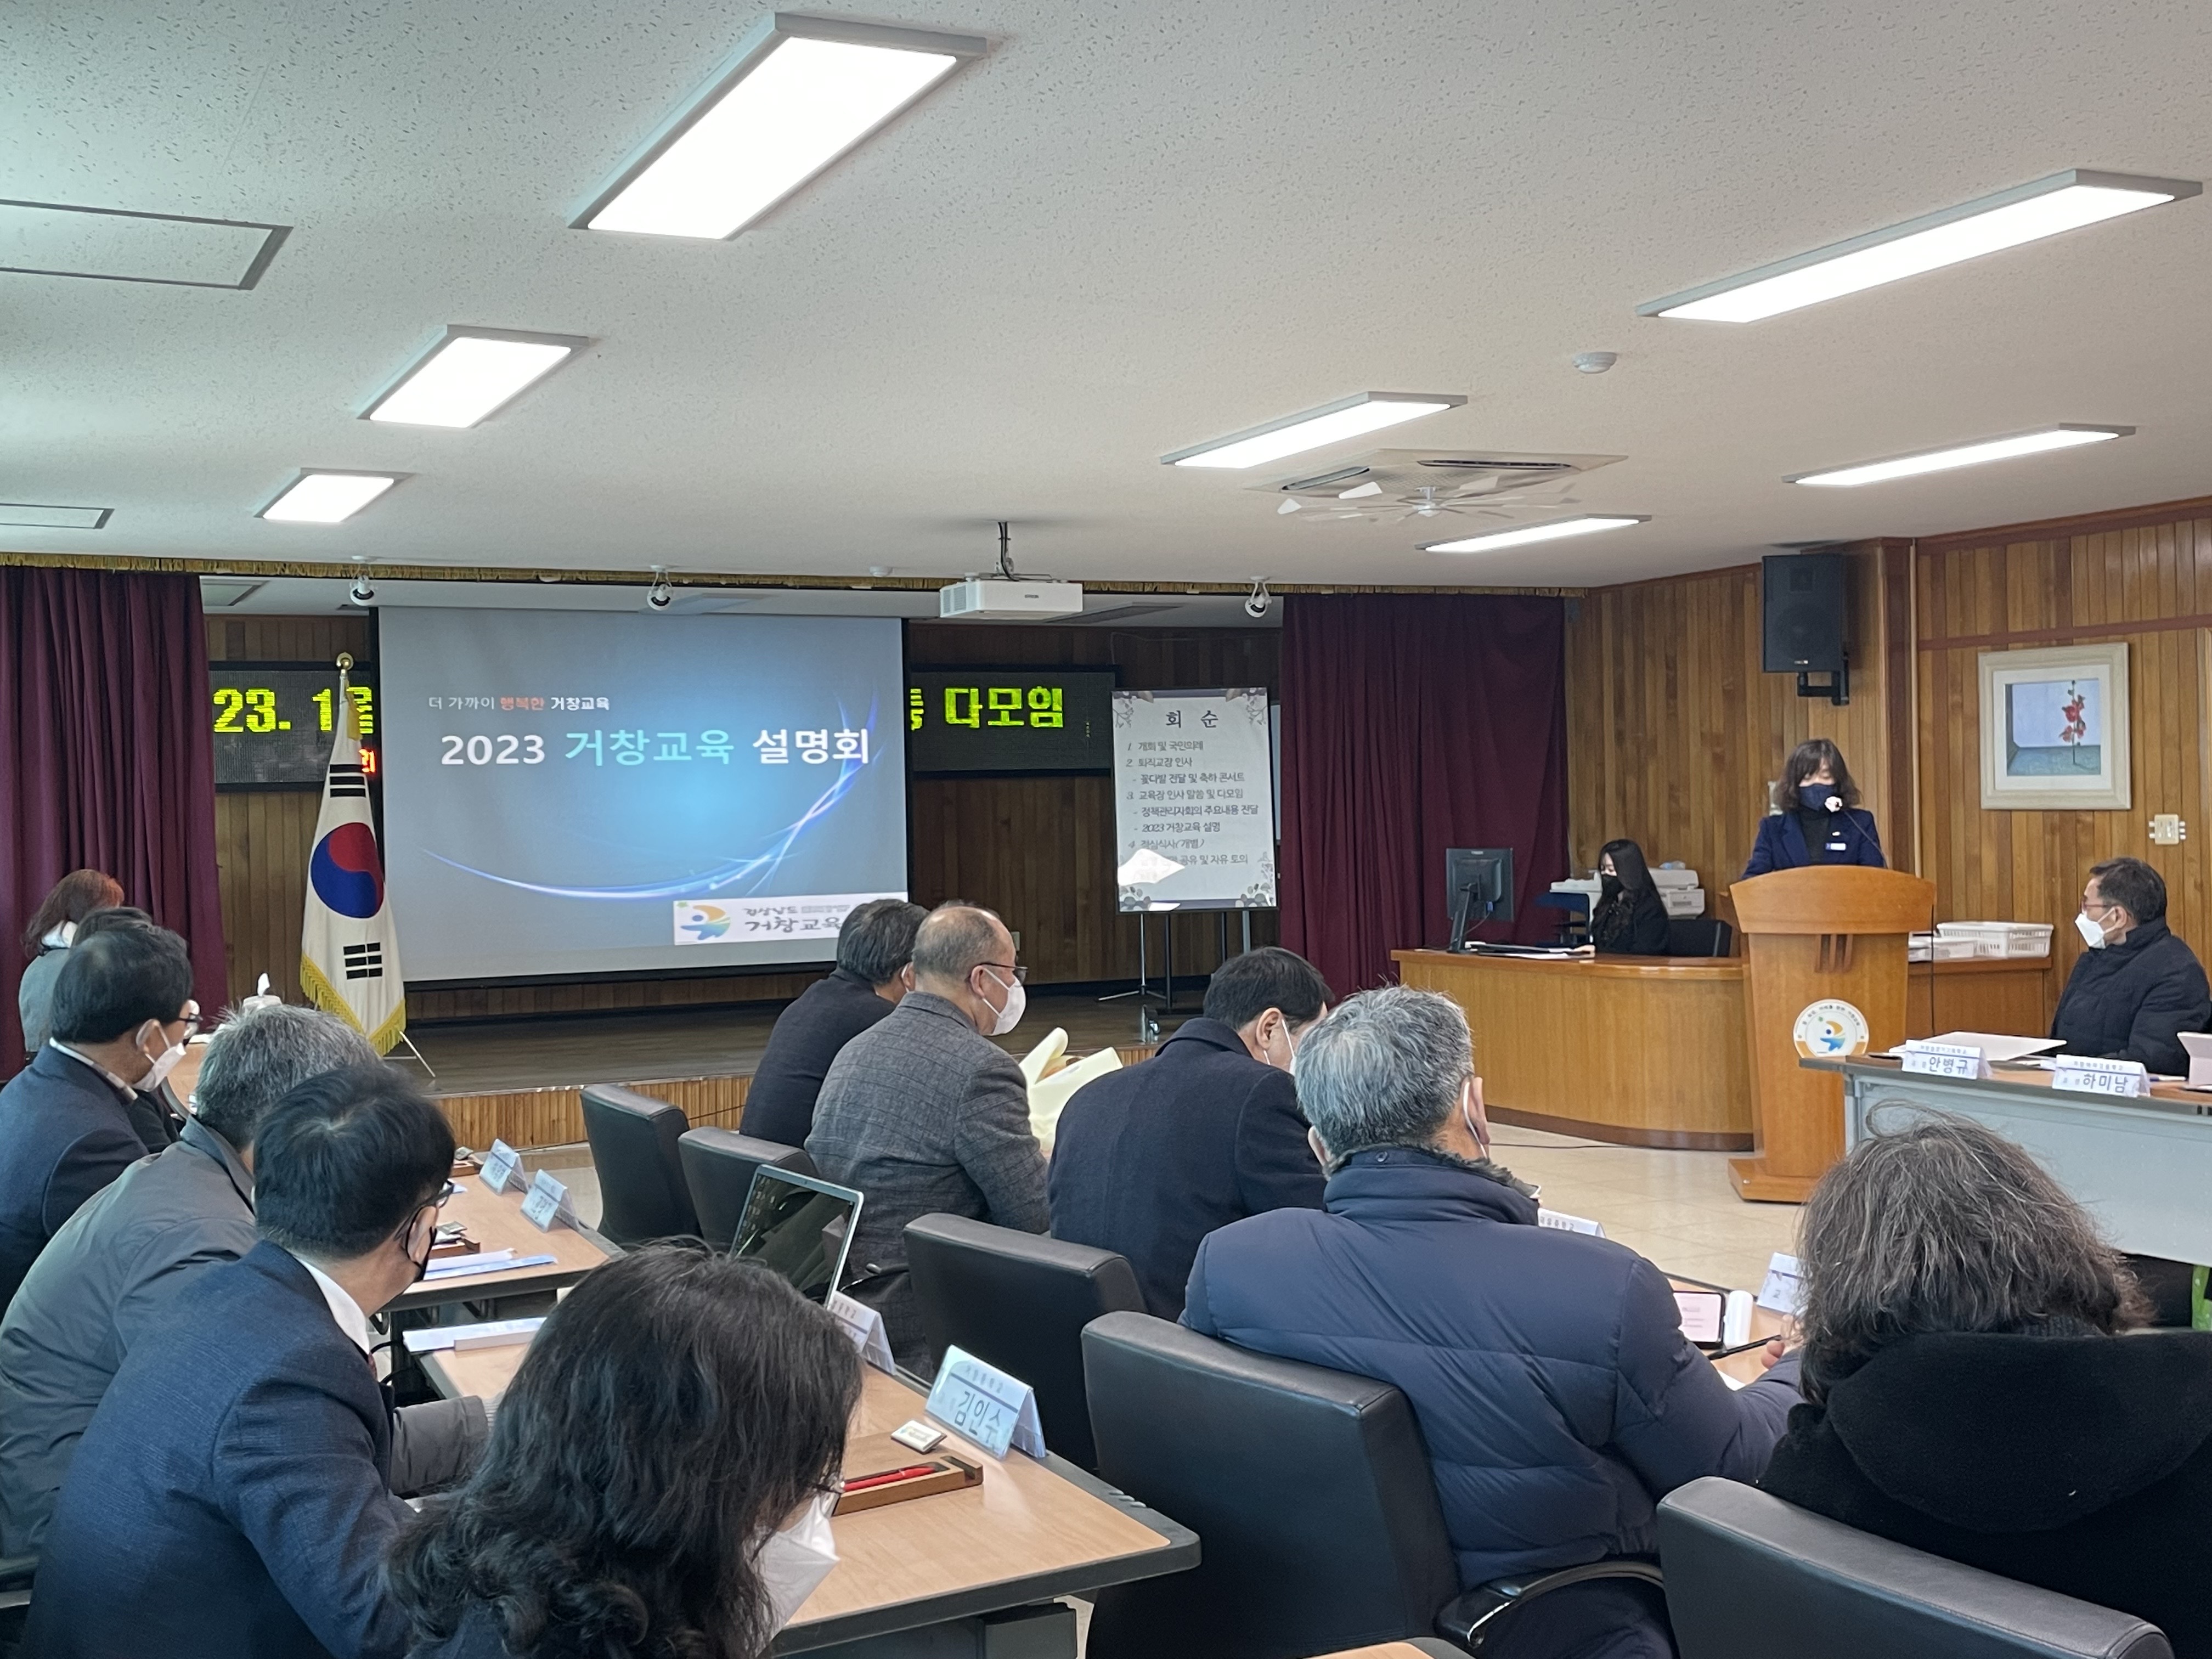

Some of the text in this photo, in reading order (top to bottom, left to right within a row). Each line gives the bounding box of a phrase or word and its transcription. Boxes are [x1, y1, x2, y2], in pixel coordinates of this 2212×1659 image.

[428, 696, 610, 711] 더 가까이 행복한 거창교육
[945, 686, 1063, 729] 다모임
[1166, 710, 1218, 728] 회 순
[441, 727, 870, 766] 2023 거창교육 설명회
[1138, 742, 1156, 751] 개회
[1158, 741, 1166, 751] 및
[1138, 758, 1173, 768] 퇴직교장
[1175, 757, 1193, 767] 인사
[1169, 774, 1186, 783] 전달
[1188, 773, 1198, 783] 및
[1199, 773, 1217, 783] 축하
[1220, 772, 1245, 783] 콘서트
[1139, 791, 1165, 800] 교육장
[1167, 790, 1184, 800] 인사
[1206, 789, 1215, 799] 및
[1204, 805, 1239, 815] 주요내용
[1241, 804, 1259, 815] 전달
[1142, 822, 1220, 833] 2023 거창교육 설명
[1200, 855, 1209, 865] 및
[1210, 854, 1228, 865] 자유
[1231, 854, 1248, 865] 토의
[1929, 1057, 1967, 1074] 안병규
[2083, 1073, 2128, 1093] 하미남
[954, 1391, 1001, 1443] 김인수
